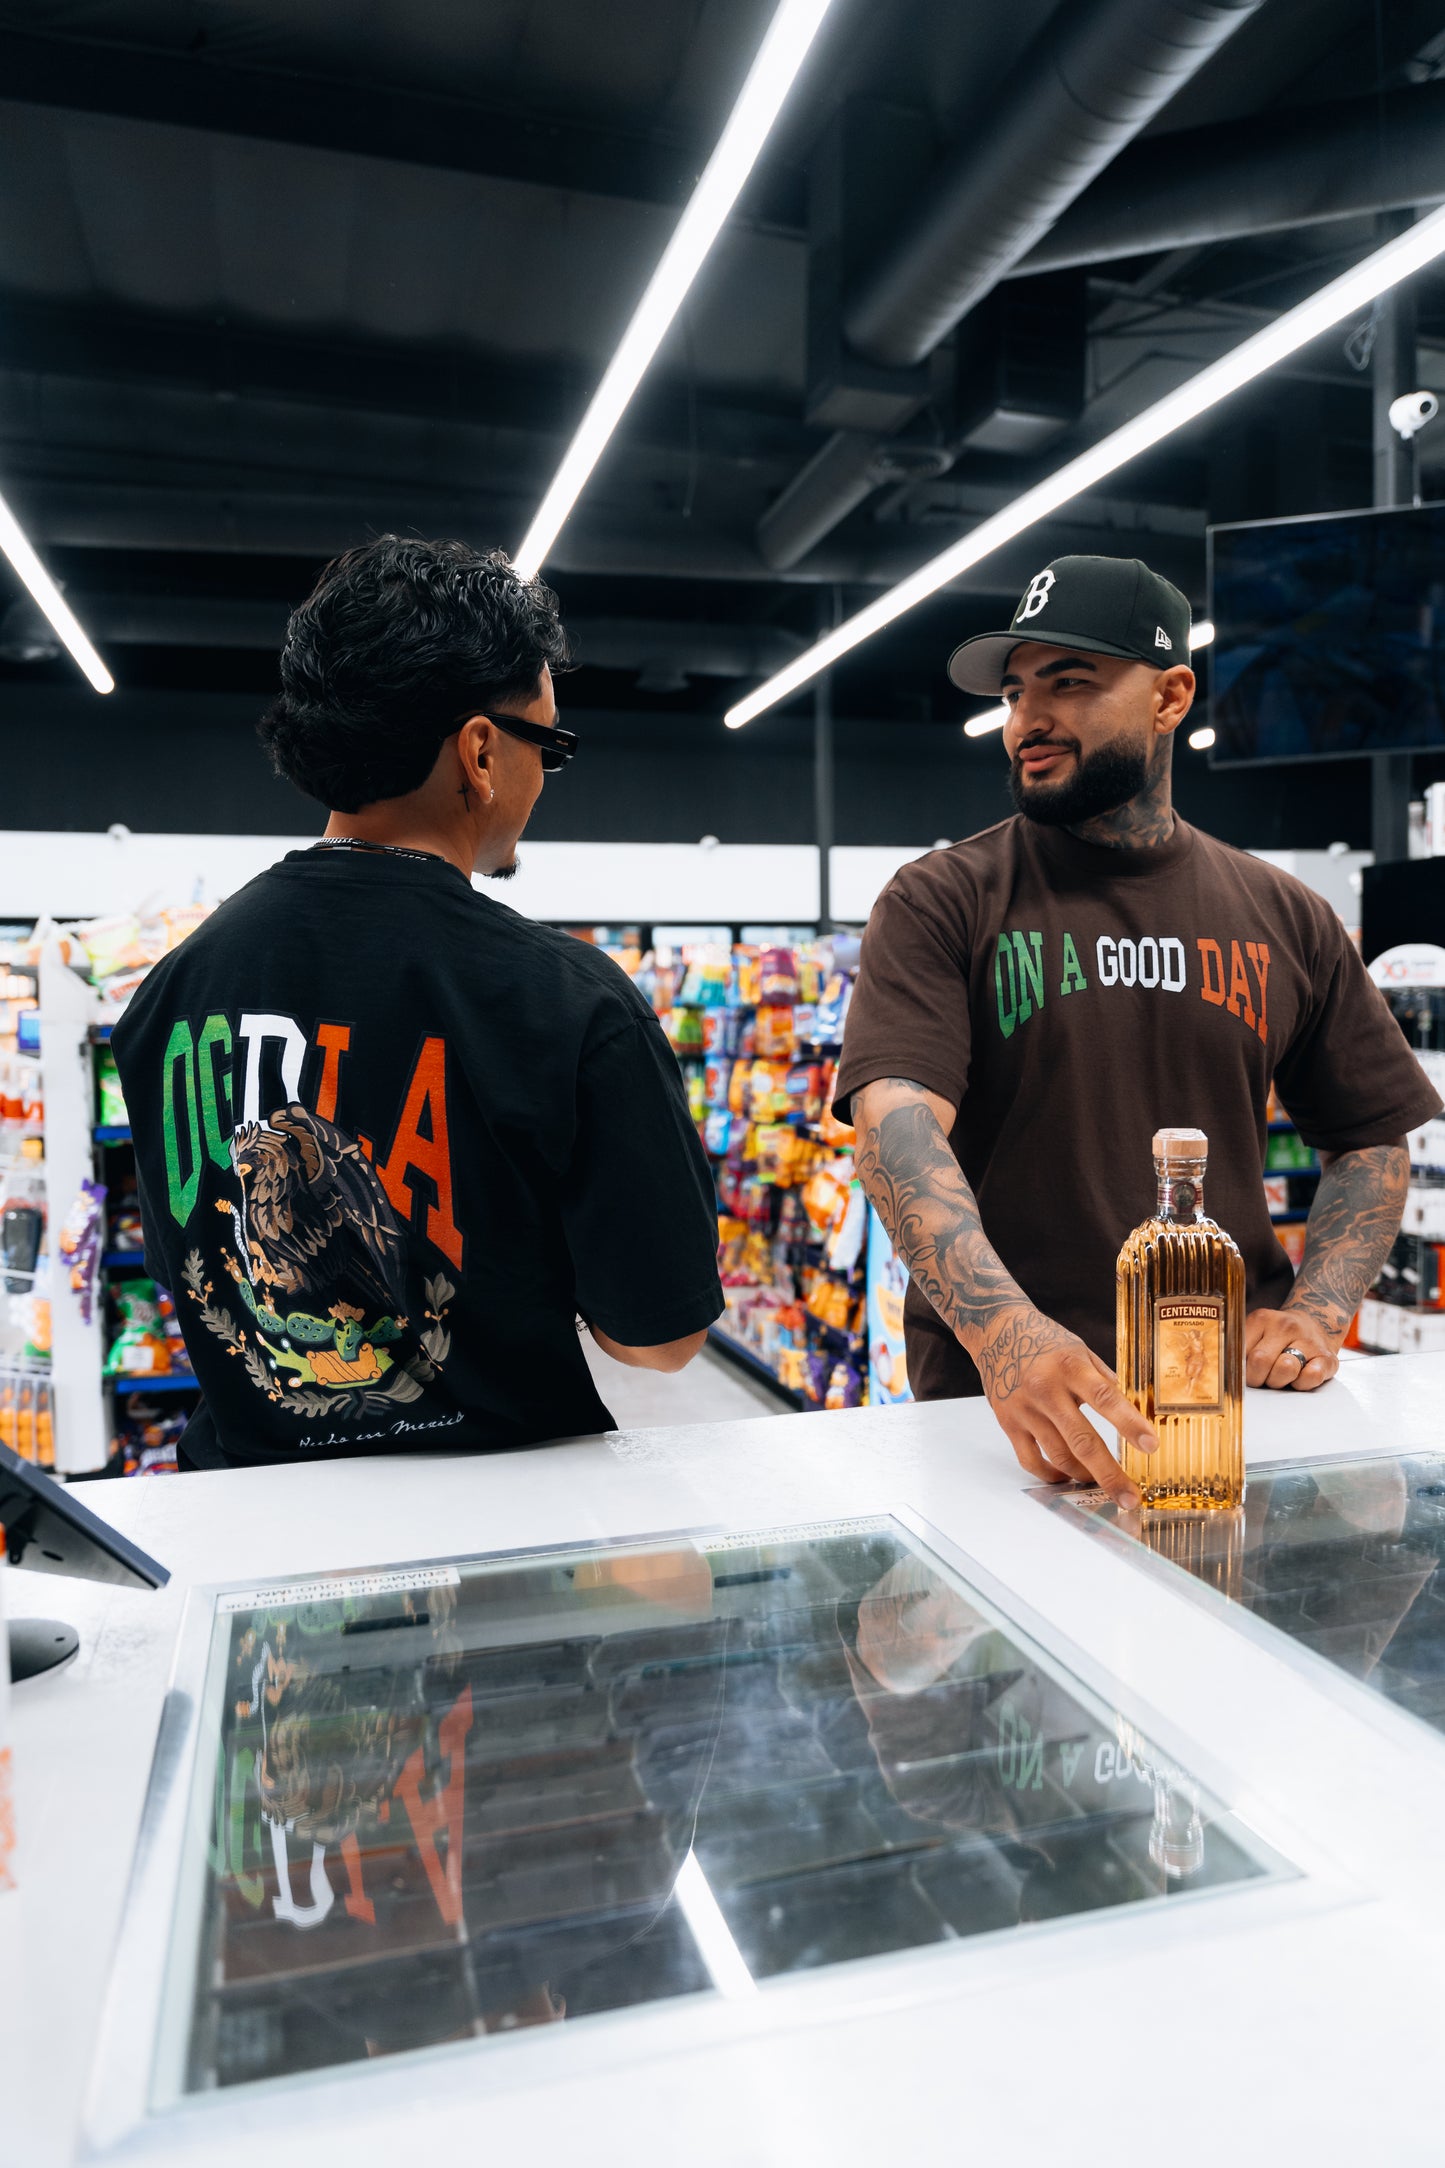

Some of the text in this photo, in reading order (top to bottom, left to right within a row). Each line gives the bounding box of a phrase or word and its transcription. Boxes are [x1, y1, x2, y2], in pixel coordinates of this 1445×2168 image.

[1016, 570, 1056, 623] B
[995, 930, 1271, 1046] ON A GOOD DAY
[1160, 1306, 1217, 1318] CENTENARIO
[352, 1586, 374, 1594] US
[379, 1578, 450, 1591] FOLLOW
[319, 1590, 345, 1599] ON
